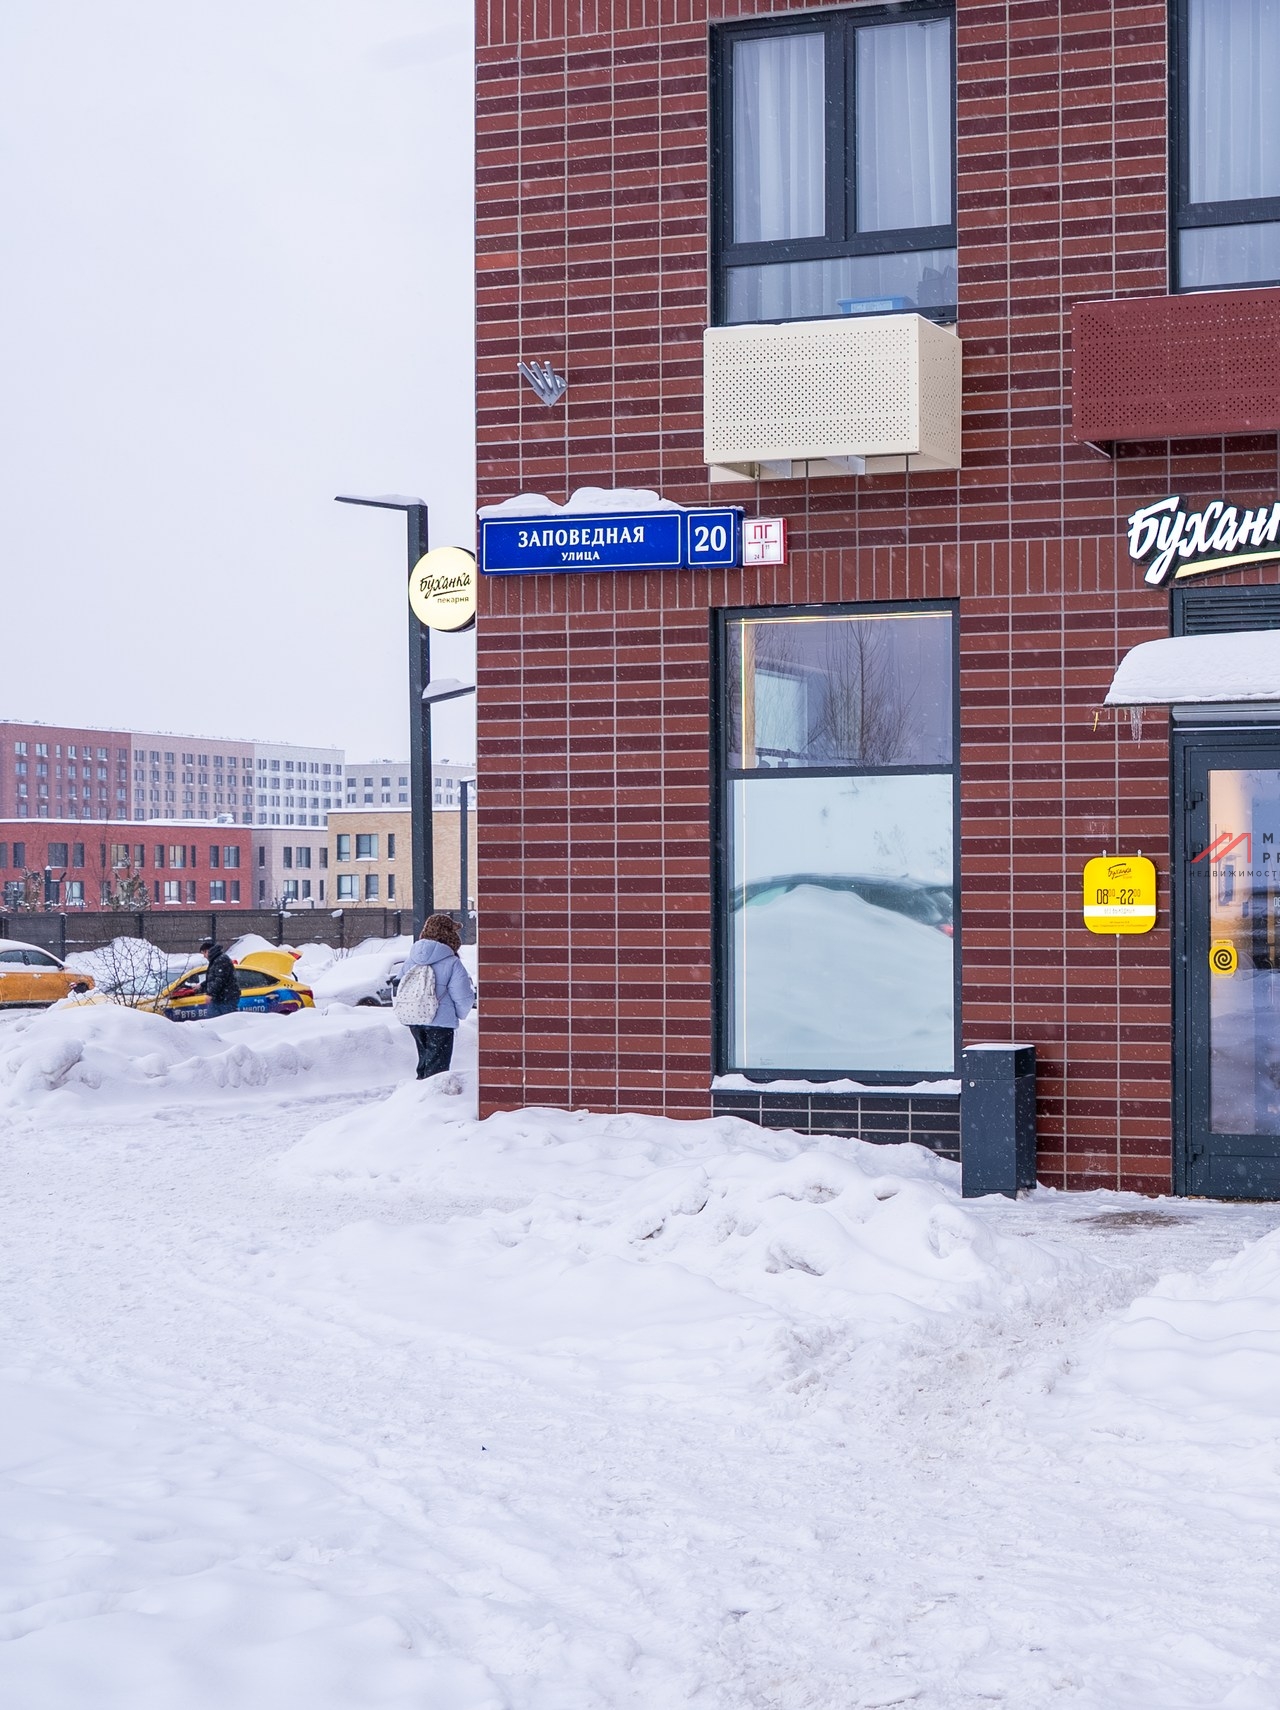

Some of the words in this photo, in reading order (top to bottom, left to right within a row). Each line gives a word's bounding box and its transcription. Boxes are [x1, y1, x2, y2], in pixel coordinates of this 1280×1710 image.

[518, 526, 645, 548] ЗАПОВЕДНАЯ
[694, 525, 727, 552] 20
[754, 524, 773, 539] ПГ
[561, 551, 601, 562] УЛИЦА
